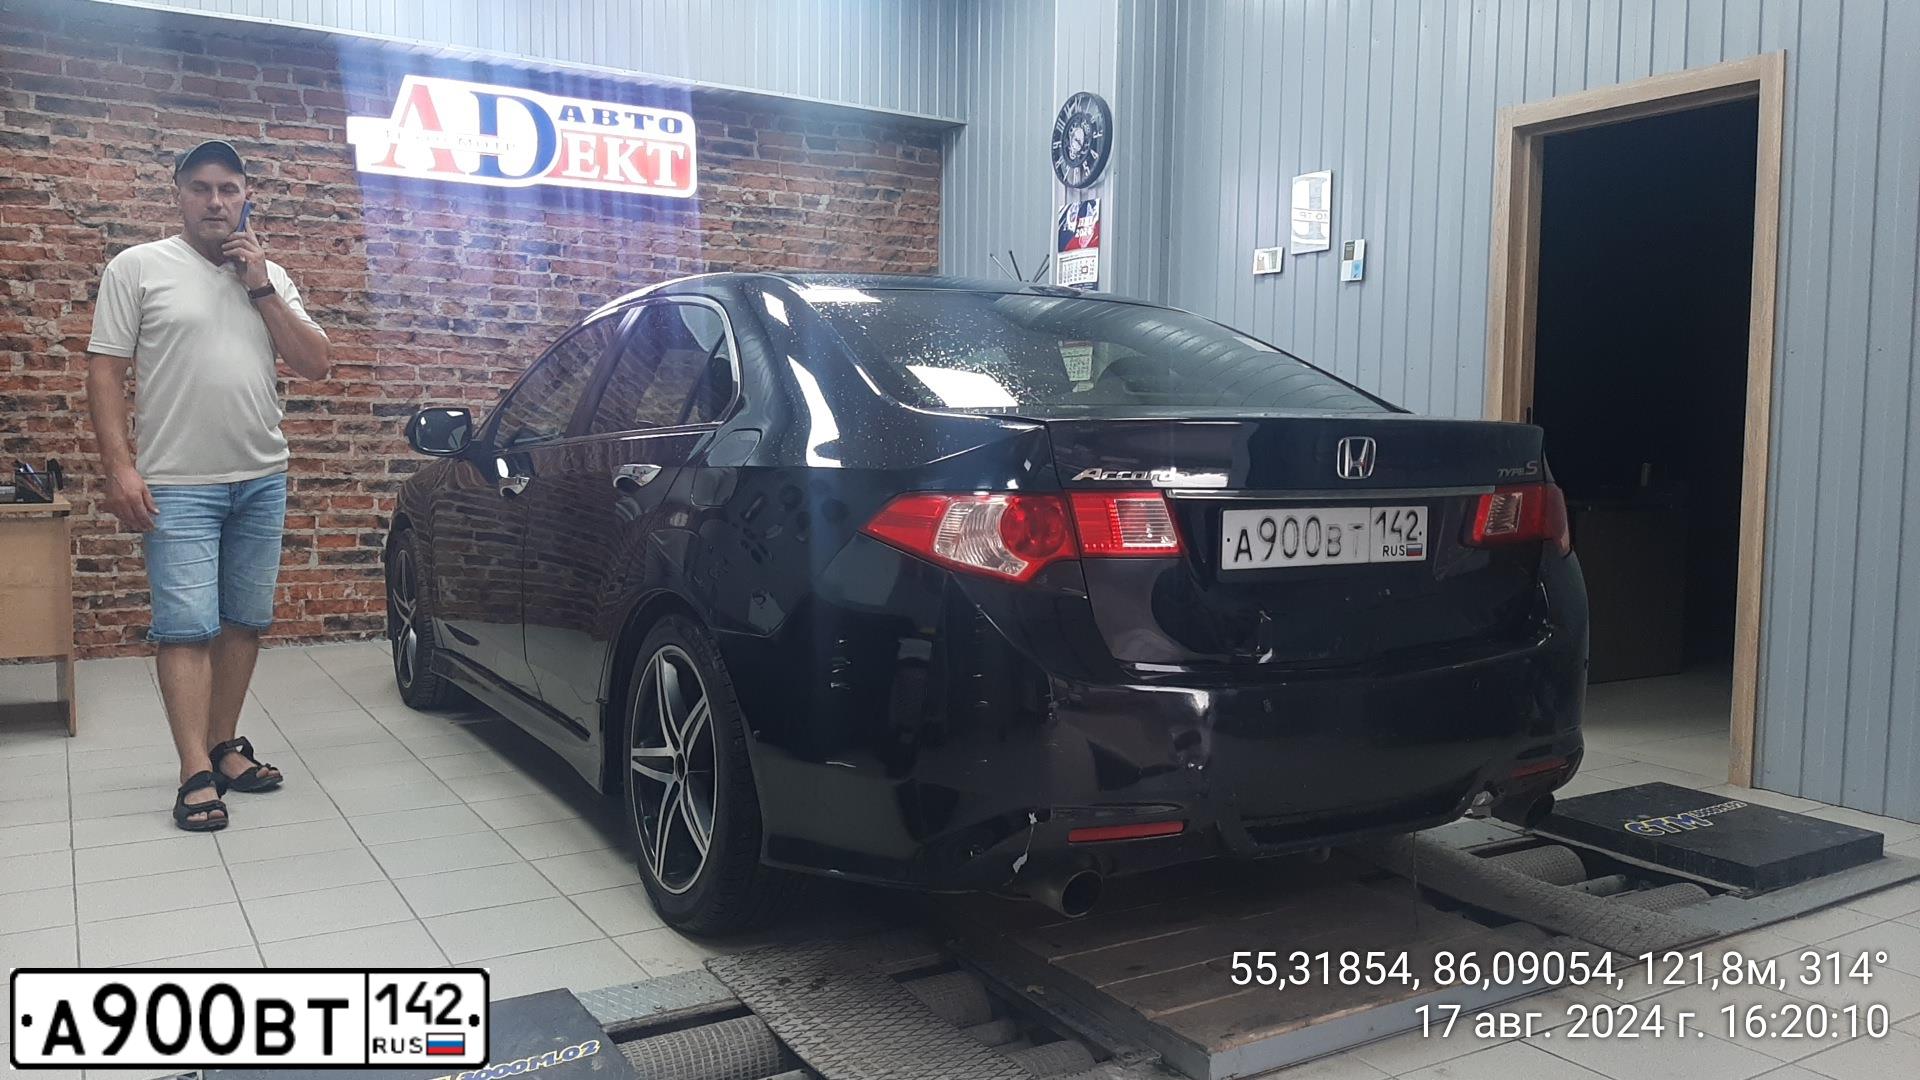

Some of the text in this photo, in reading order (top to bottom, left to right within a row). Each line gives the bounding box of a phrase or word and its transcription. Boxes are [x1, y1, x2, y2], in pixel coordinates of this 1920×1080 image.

[558, 104, 683, 134] АВТО
[1071, 467, 1177, 482] Accord
[1375, 509, 1419, 542] 142
[1382, 544, 1406, 557] RUS
